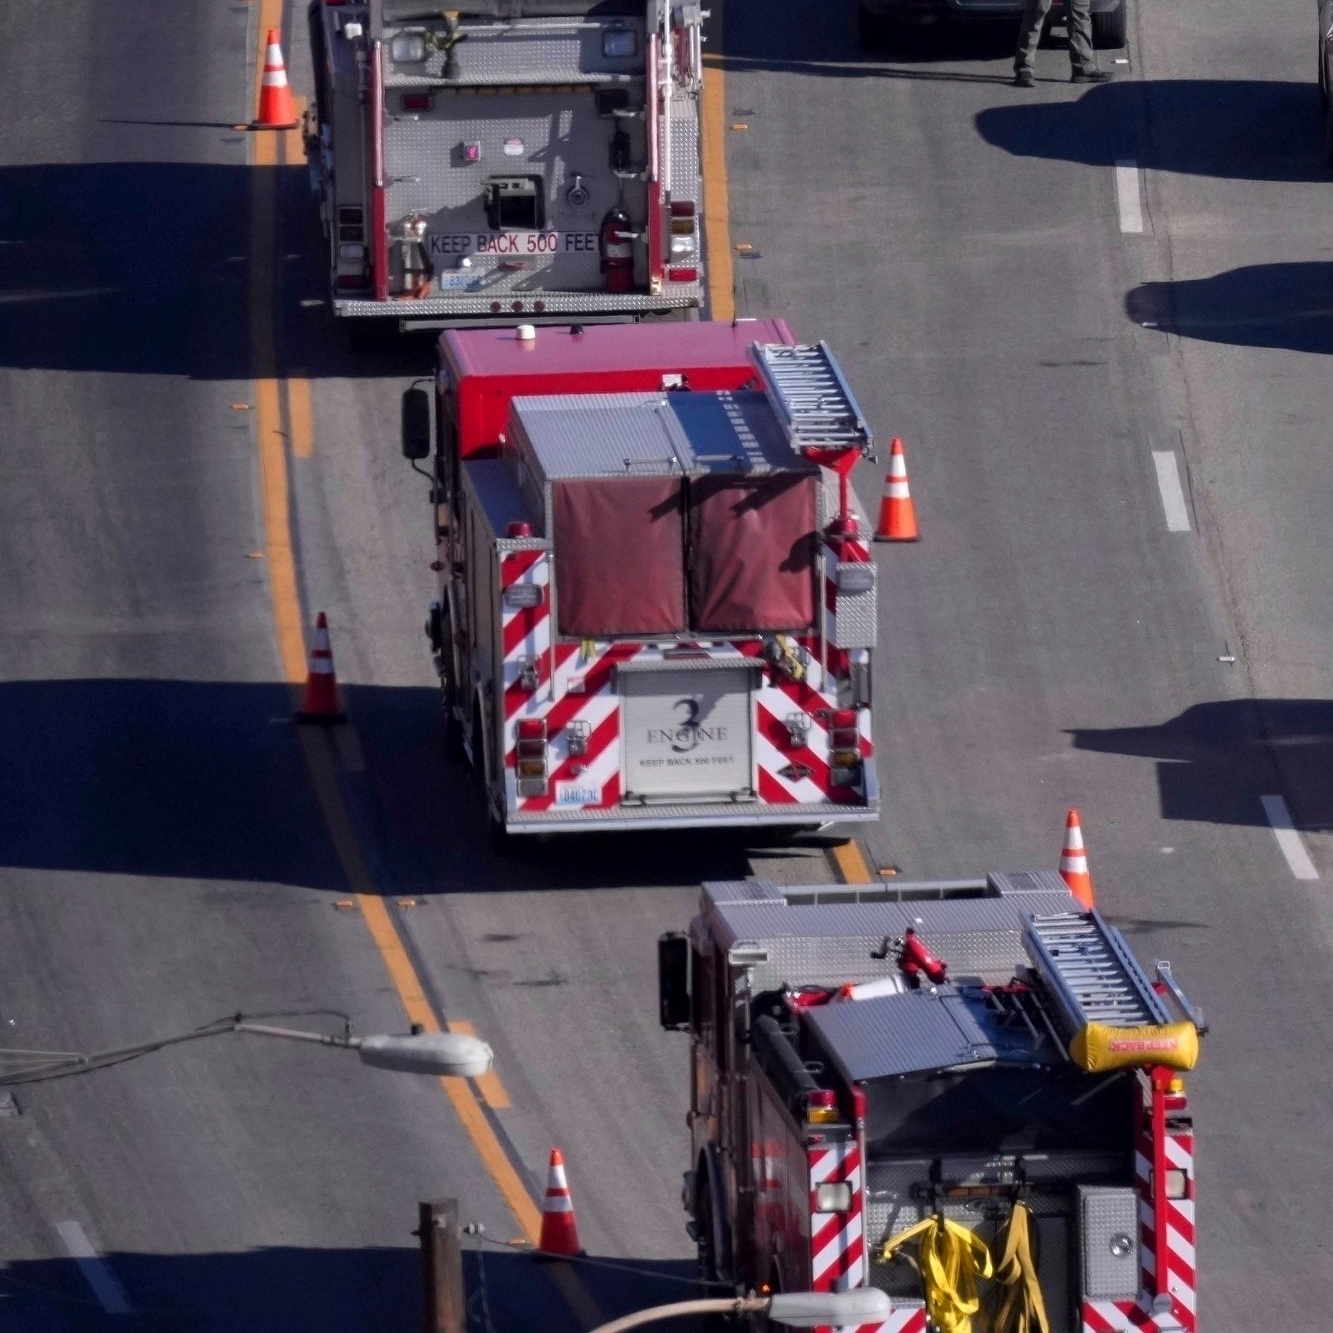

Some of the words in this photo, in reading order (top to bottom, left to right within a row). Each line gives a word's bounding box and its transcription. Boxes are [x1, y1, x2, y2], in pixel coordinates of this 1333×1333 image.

[431, 235, 471, 254] KEEP
[477, 234, 519, 253] BACK
[527, 233, 558, 253] 500
[646, 726, 729, 744] ENGINE
[672, 698, 700, 754] 3
